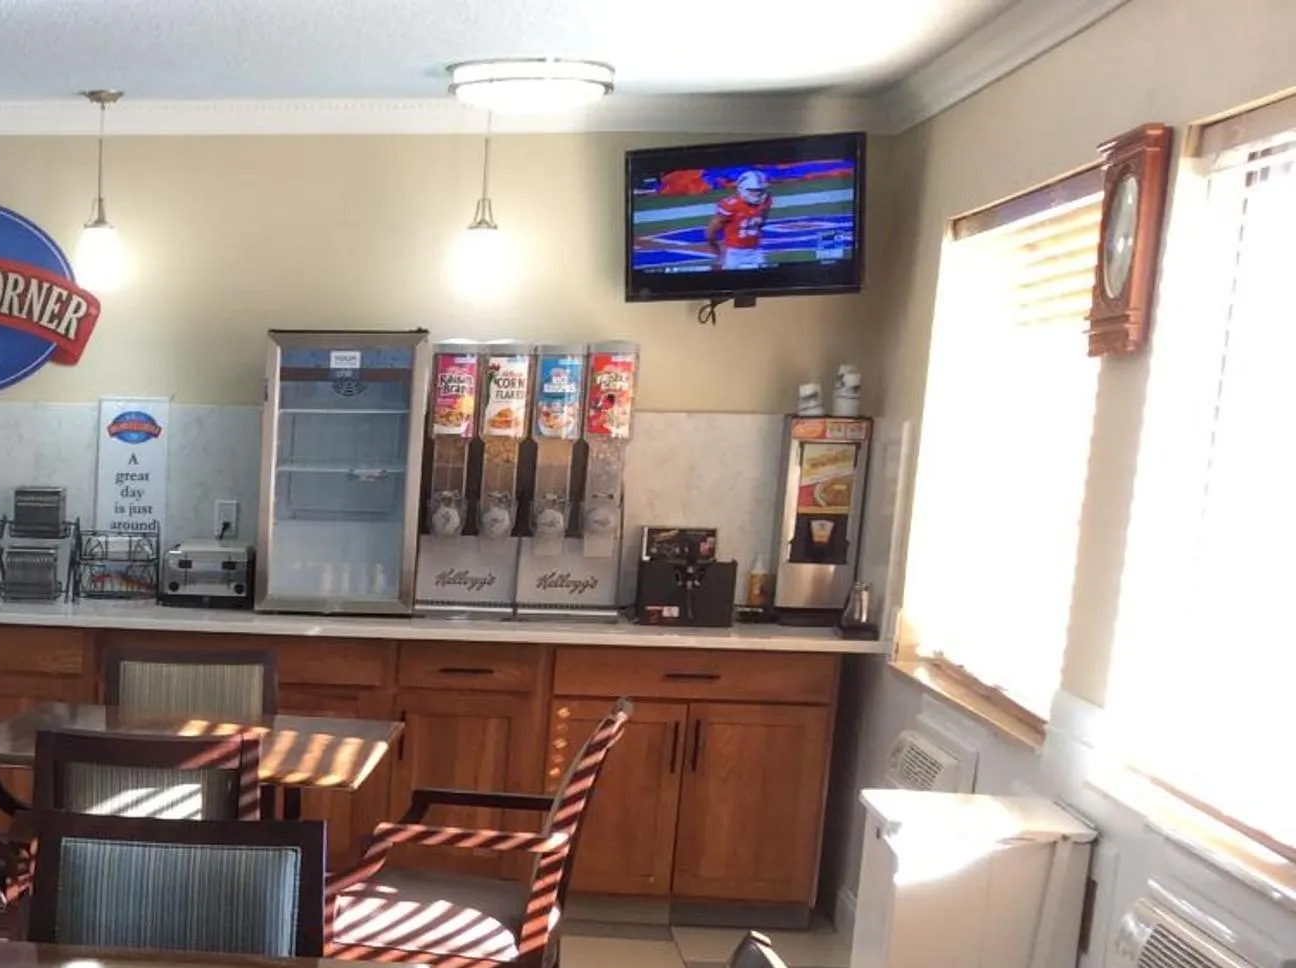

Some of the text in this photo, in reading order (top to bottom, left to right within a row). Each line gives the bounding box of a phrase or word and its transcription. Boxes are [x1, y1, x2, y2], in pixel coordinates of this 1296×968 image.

[128, 453, 139, 465] A
[115, 472, 150, 484] great
[120, 486, 145, 501] day
[114, 502, 153, 517] is just
[110, 519, 157, 531] around
[435, 568, 496, 591] Kellogg's
[535, 572, 598, 595] Kellogg's
